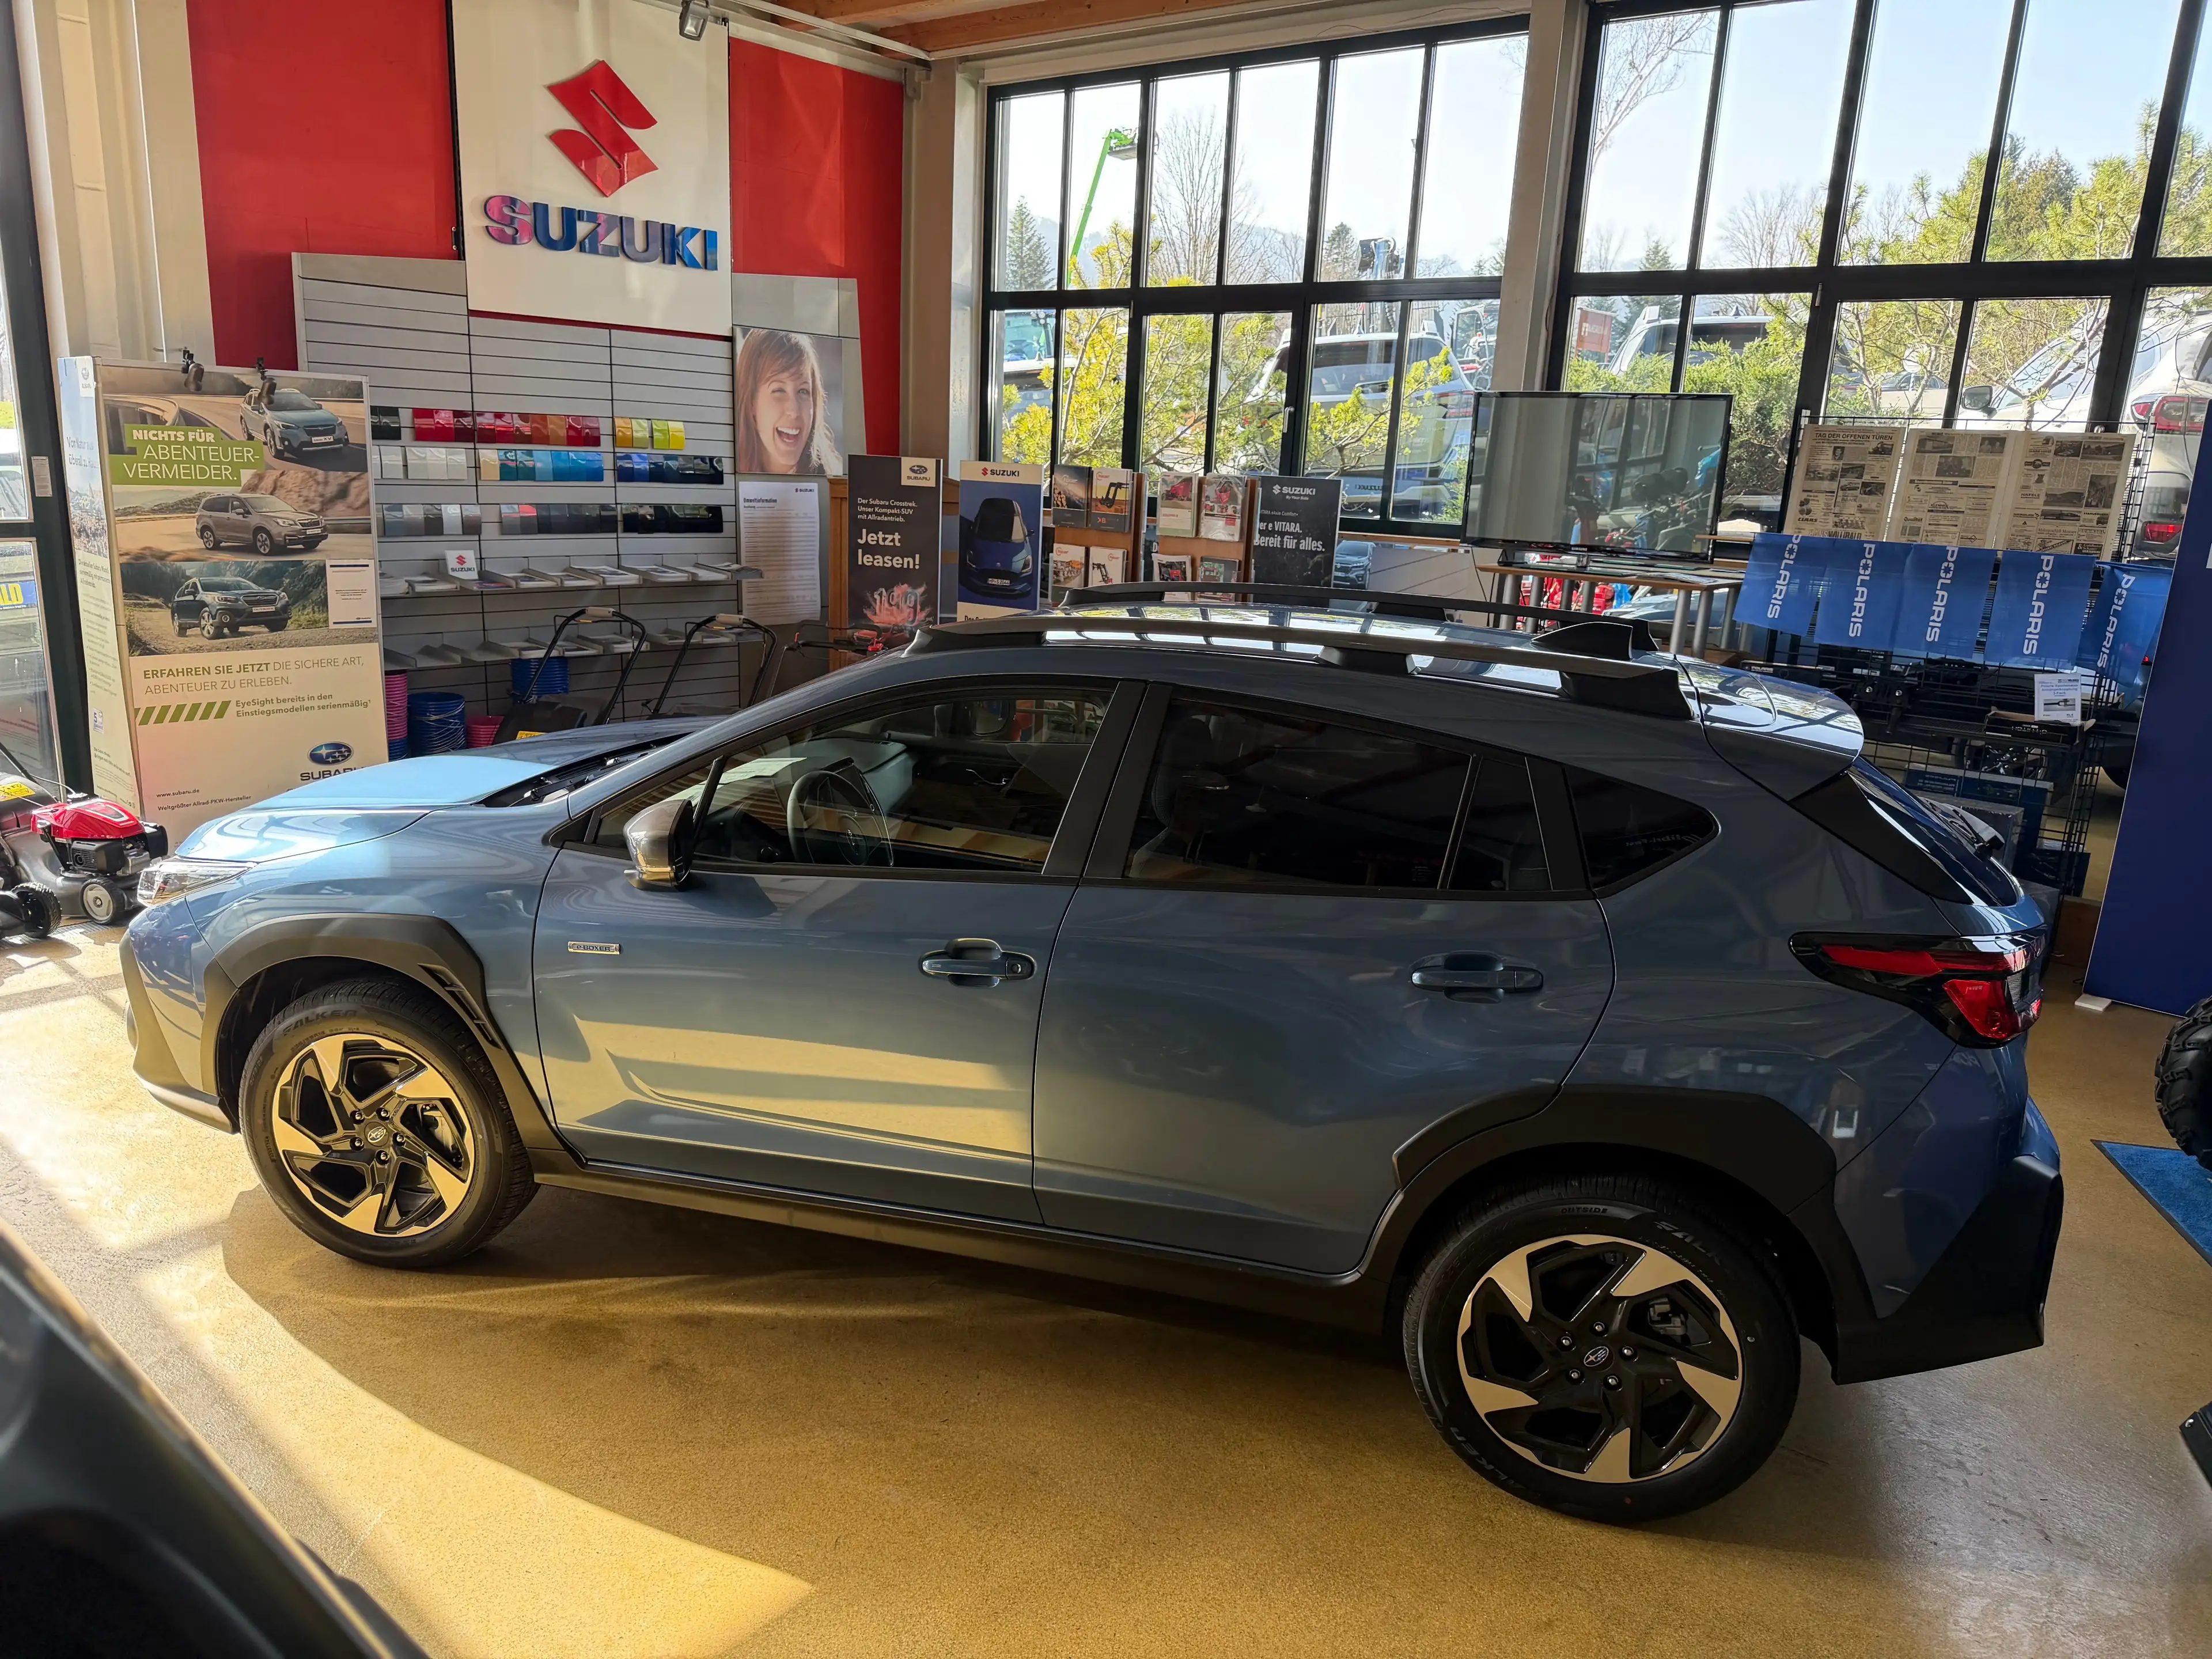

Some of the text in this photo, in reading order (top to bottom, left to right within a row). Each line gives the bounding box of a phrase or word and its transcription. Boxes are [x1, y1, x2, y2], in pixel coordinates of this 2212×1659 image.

[484, 195, 718, 271] SUZUKI
[67, 437, 75, 448] Von
[132, 429, 215, 442] NICHTS FÜR
[143, 445, 259, 463] ABENTEUER-
[123, 463, 237, 480] VERMEIDER.
[990, 469, 1020, 477] SUZUKI
[1282, 486, 1316, 495] SUZUKI
[875, 507, 913, 515] Kompakt-SUV
[1274, 521, 1302, 533] VITARA.
[857, 528, 901, 546] Jetzt
[1283, 535, 1297, 549] für
[1300, 537, 1325, 552] alles.
[858, 549, 920, 569] leasen!
[1767, 535, 1801, 618] POLARIS
[1849, 543, 1876, 637] POLARIS
[1926, 546, 1959, 642] POLARIS
[2023, 555, 2054, 655] POLARIS
[2097, 573, 2136, 669] POLARIS
[143, 656, 364, 679] ERFAHREN SIE JETZT DIE SICHERE ART,
[145, 676, 292, 695] ABENTEUER ZU ERLEBEN.
[236, 698, 274, 708] EyeSight
[276, 695, 305, 704] bereits
[236, 704, 315, 717] Einstiegsmodellen
[300, 767, 364, 781] SUBA
[156, 789, 199, 798] www.subaru.de
[158, 795, 251, 812] Weltgrößter Allrad-PKW-Hersteller
[282, 1010, 358, 1036] FALKEN
[1560, 1206, 1608, 1214] OUTSIDE
